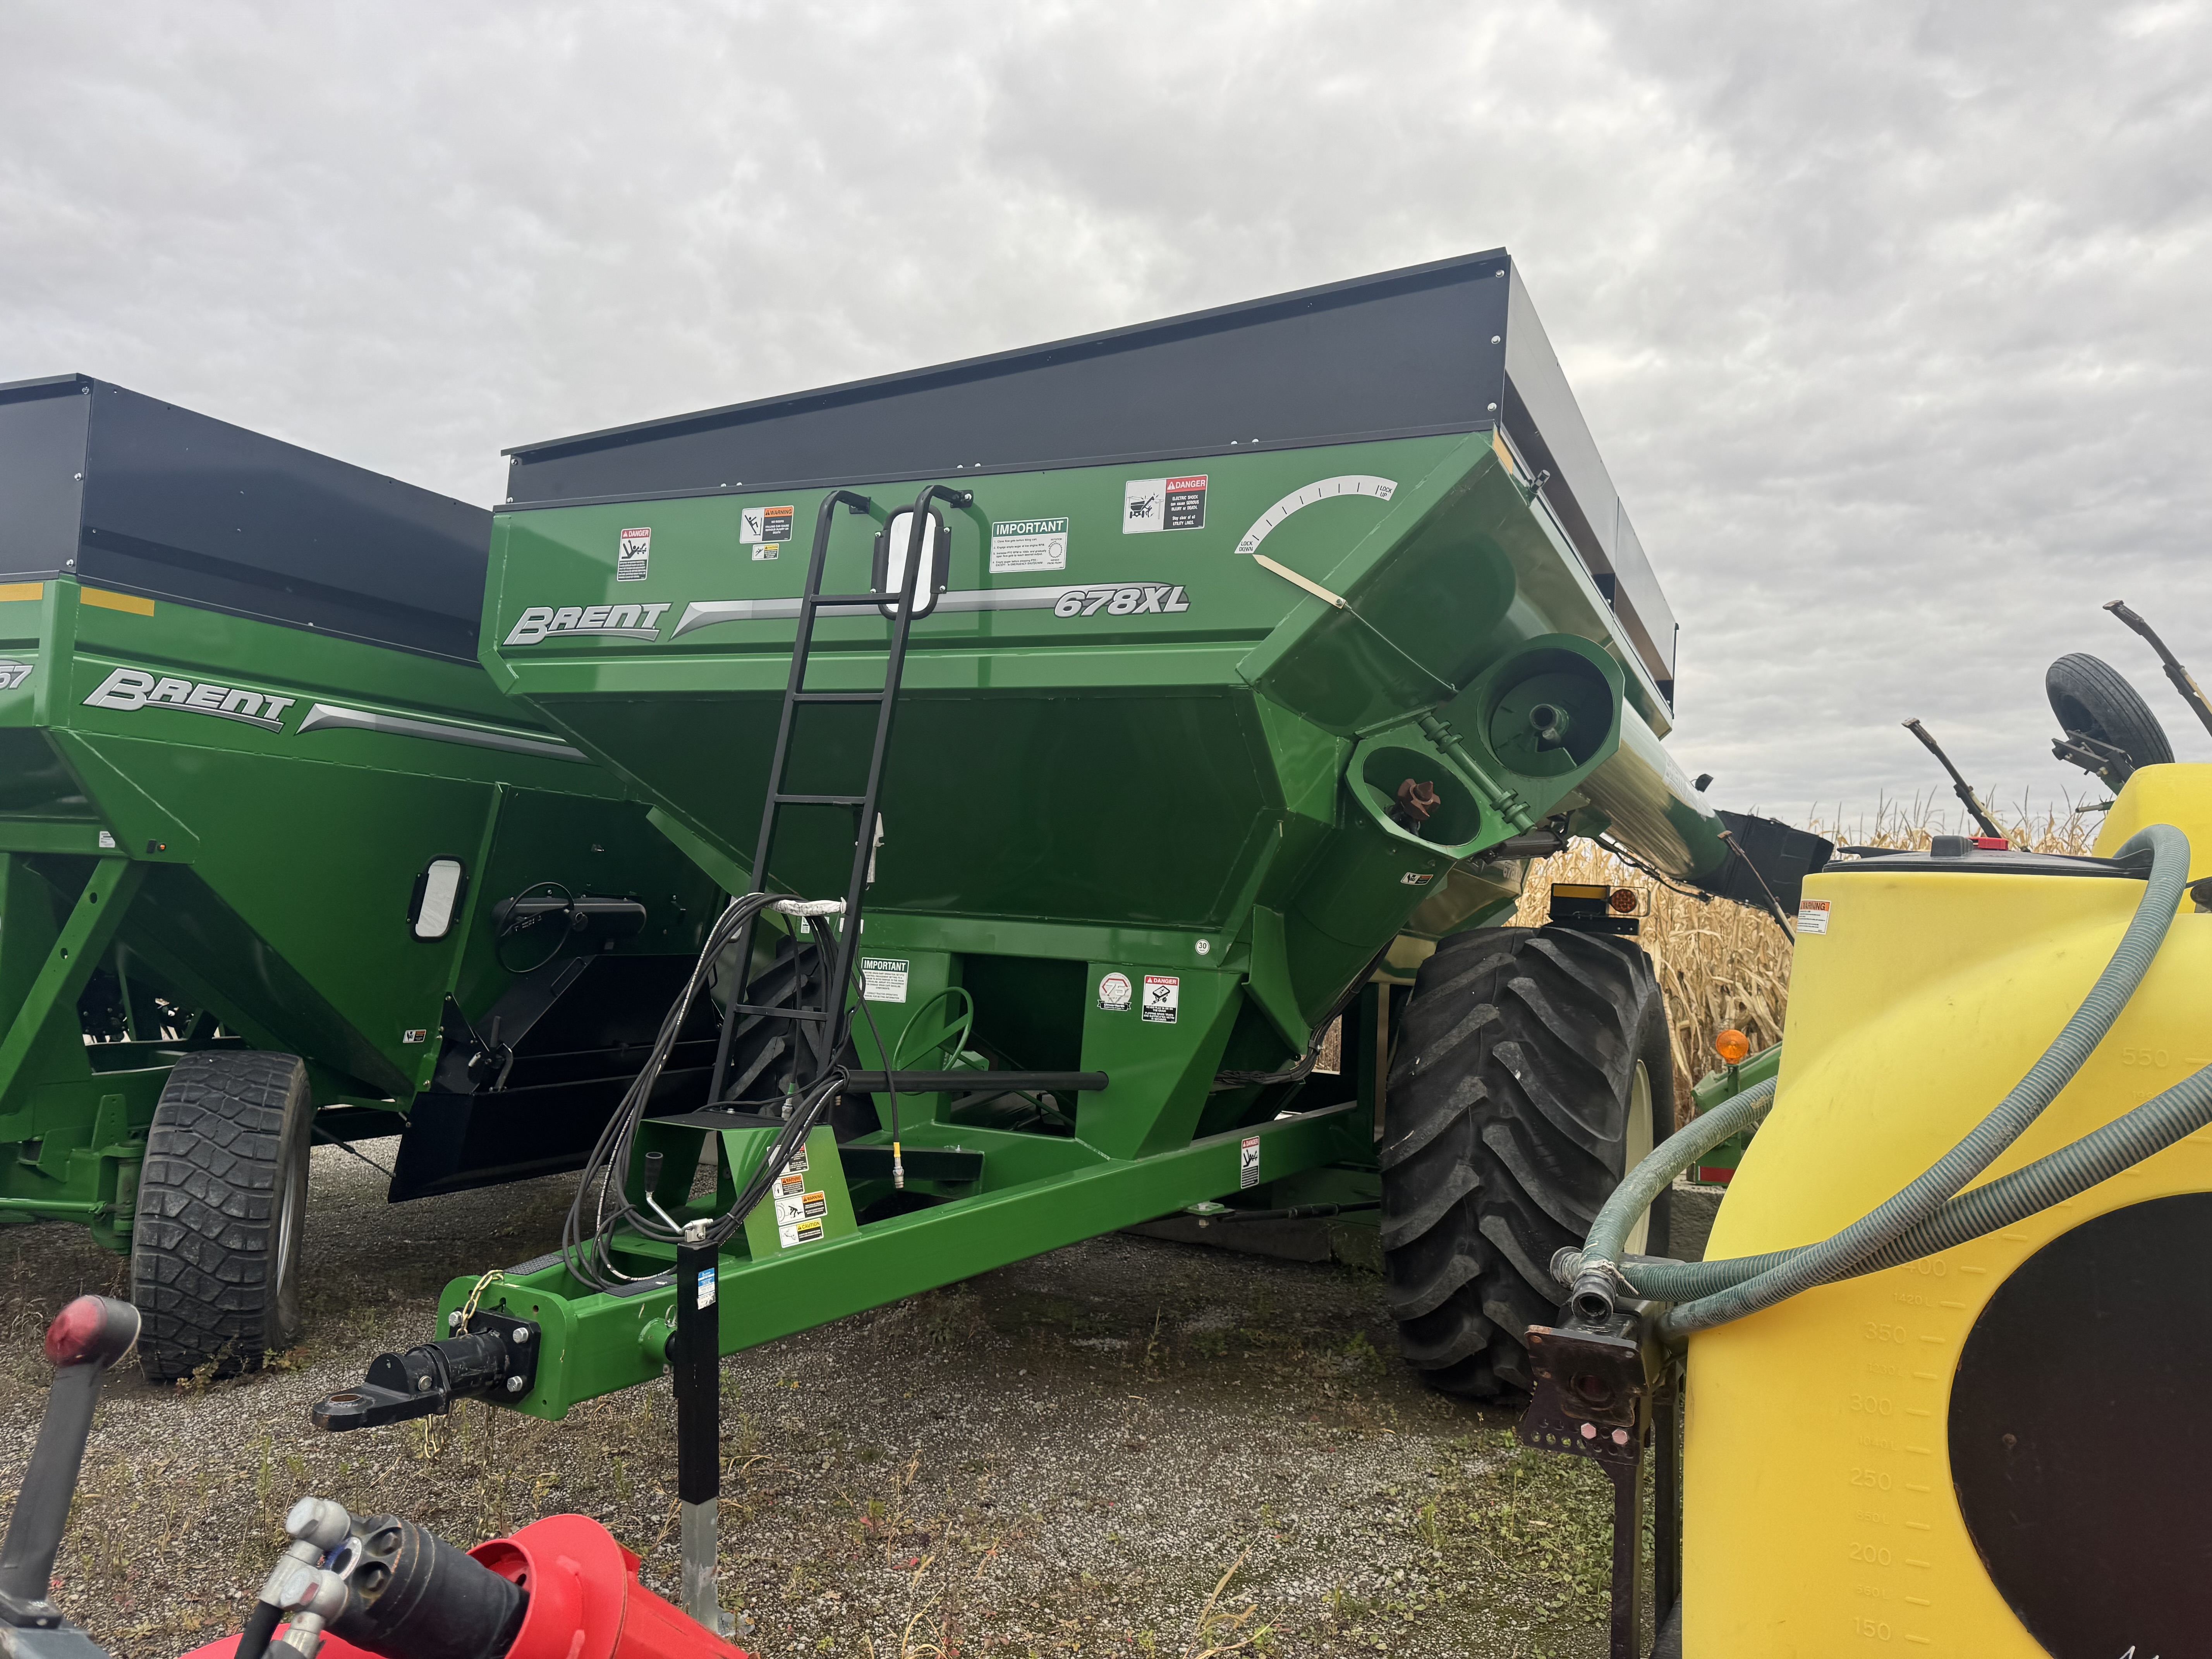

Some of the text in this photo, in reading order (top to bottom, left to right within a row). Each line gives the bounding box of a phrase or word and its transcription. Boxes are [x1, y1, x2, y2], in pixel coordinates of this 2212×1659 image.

[1176, 480, 1206, 488] DANGER
[997, 520, 1064, 535] IMPORTANT
[1054, 585, 1191, 618] 678XL
[502, 603, 673, 646] BRENT
[81, 668, 296, 721] BRENT
[864, 960, 906, 971] IMPORTANT
[1105, 982, 1126, 996] 75
[2123, 1047, 2169, 1068] 550
[1865, 1322, 1906, 1344] 350
[1850, 1394, 1891, 1415] 300
[1850, 1468, 1891, 1491] 250
[1850, 1542, 1891, 1566] 200
[1854, 1617, 1891, 1641] 150
